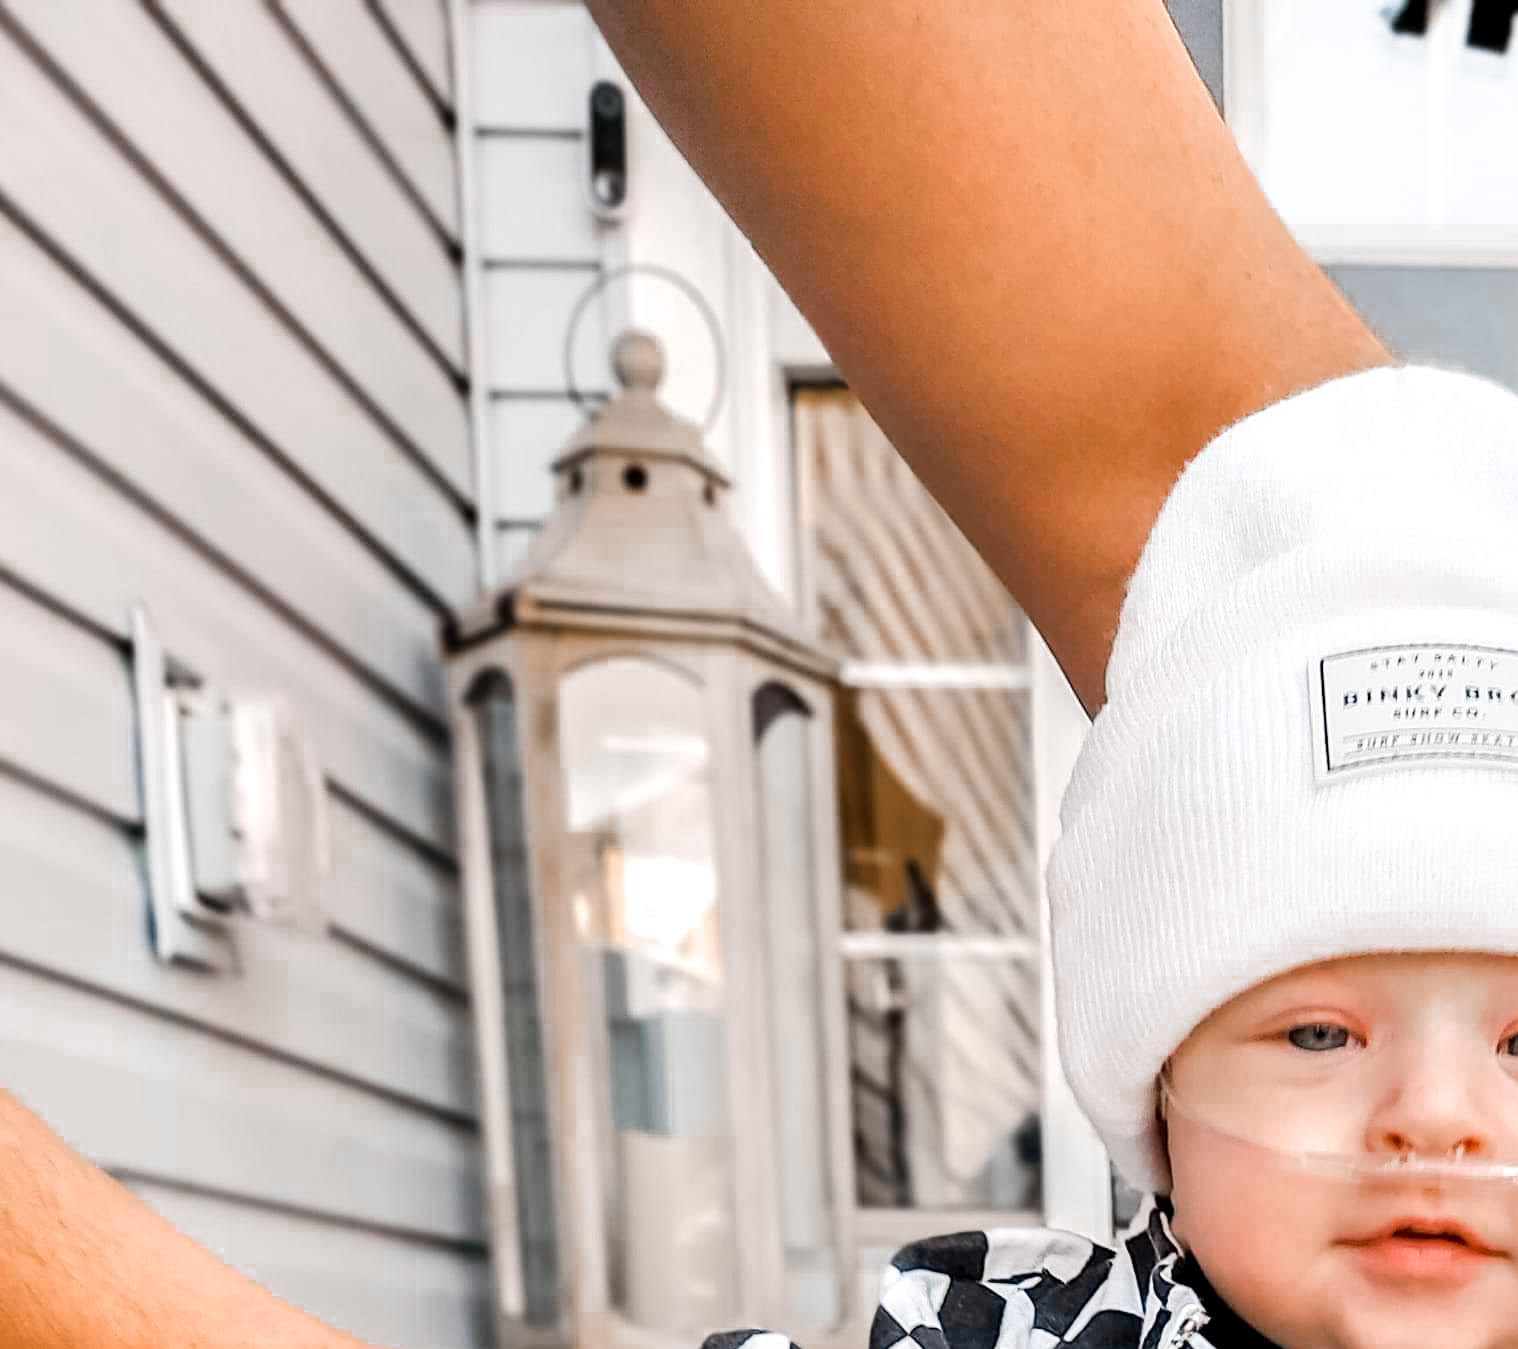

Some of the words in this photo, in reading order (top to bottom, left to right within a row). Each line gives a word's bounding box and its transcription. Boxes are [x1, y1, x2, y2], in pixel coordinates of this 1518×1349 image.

[1434, 653, 1498, 671] SALTY
[1343, 684, 1446, 708] BINKY
[1393, 706, 1442, 720] SURF
[1357, 733, 1401, 751] SURF
[1410, 731, 1460, 747] SNOW
